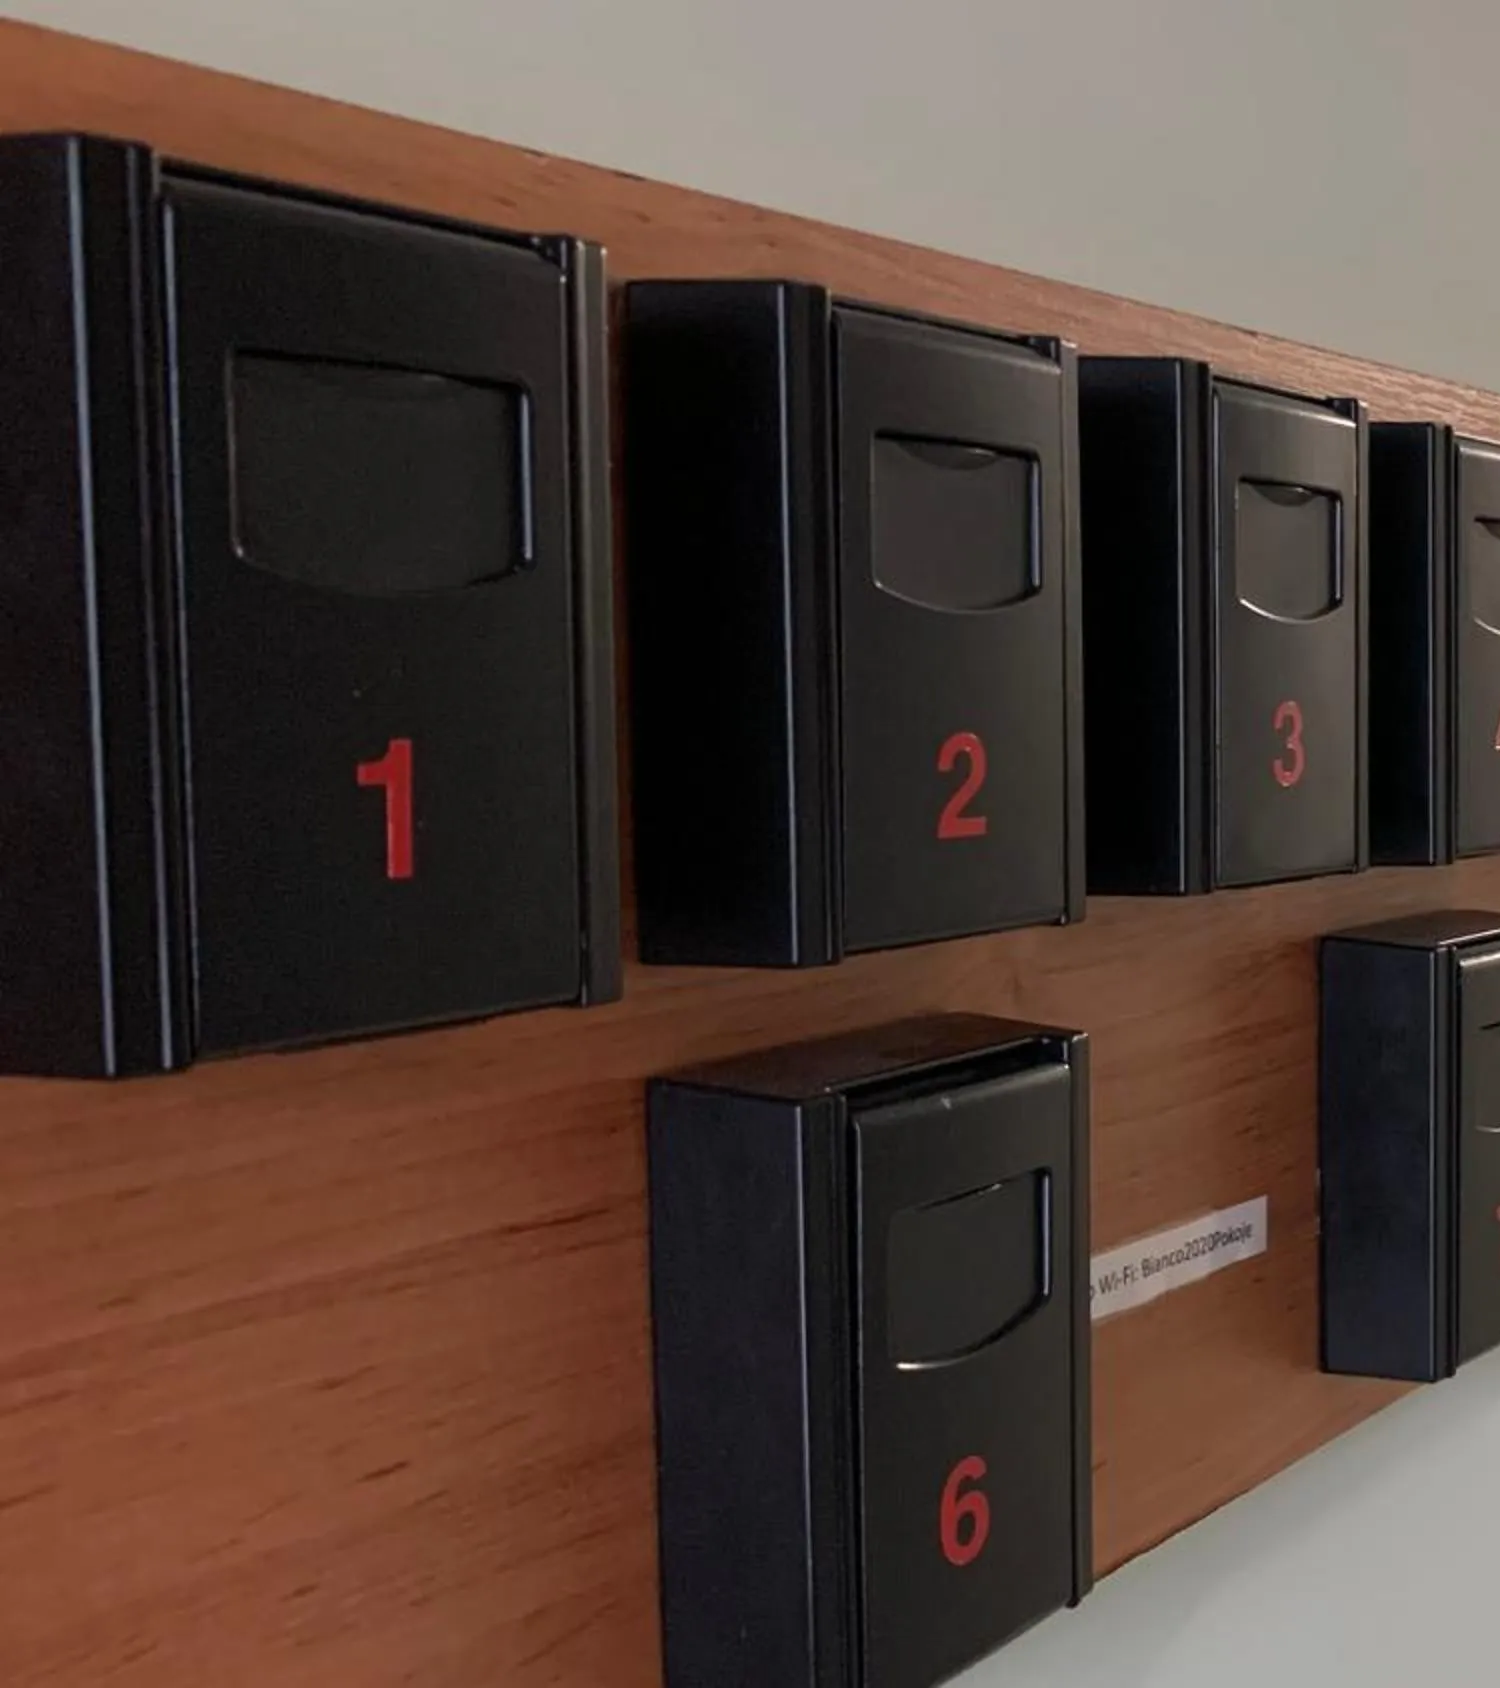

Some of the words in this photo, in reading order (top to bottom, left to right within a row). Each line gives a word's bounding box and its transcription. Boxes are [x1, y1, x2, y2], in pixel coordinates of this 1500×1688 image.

[937, 731, 987, 838] 2
[1273, 700, 1305, 787] 3
[357, 738, 412, 878] 1
[940, 1455, 990, 1566] 6
